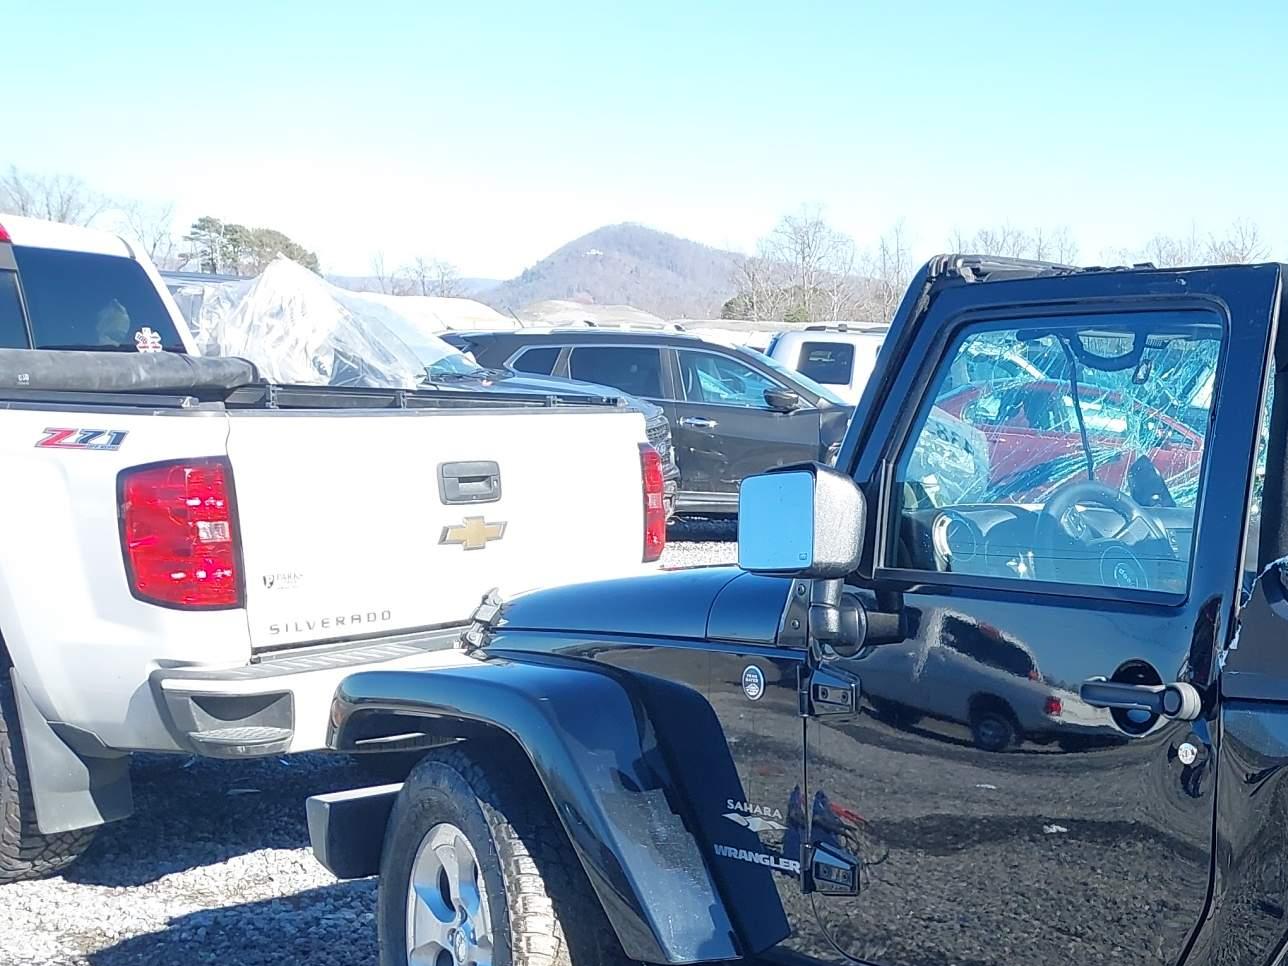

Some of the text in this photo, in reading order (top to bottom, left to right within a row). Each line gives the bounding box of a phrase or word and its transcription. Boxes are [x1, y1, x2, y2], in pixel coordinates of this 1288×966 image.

[34, 427, 130, 451] Z71
[269, 609, 392, 635] SILVERADO
[726, 799, 783, 819] SAHARA
[713, 843, 801, 875] WRANGLER
